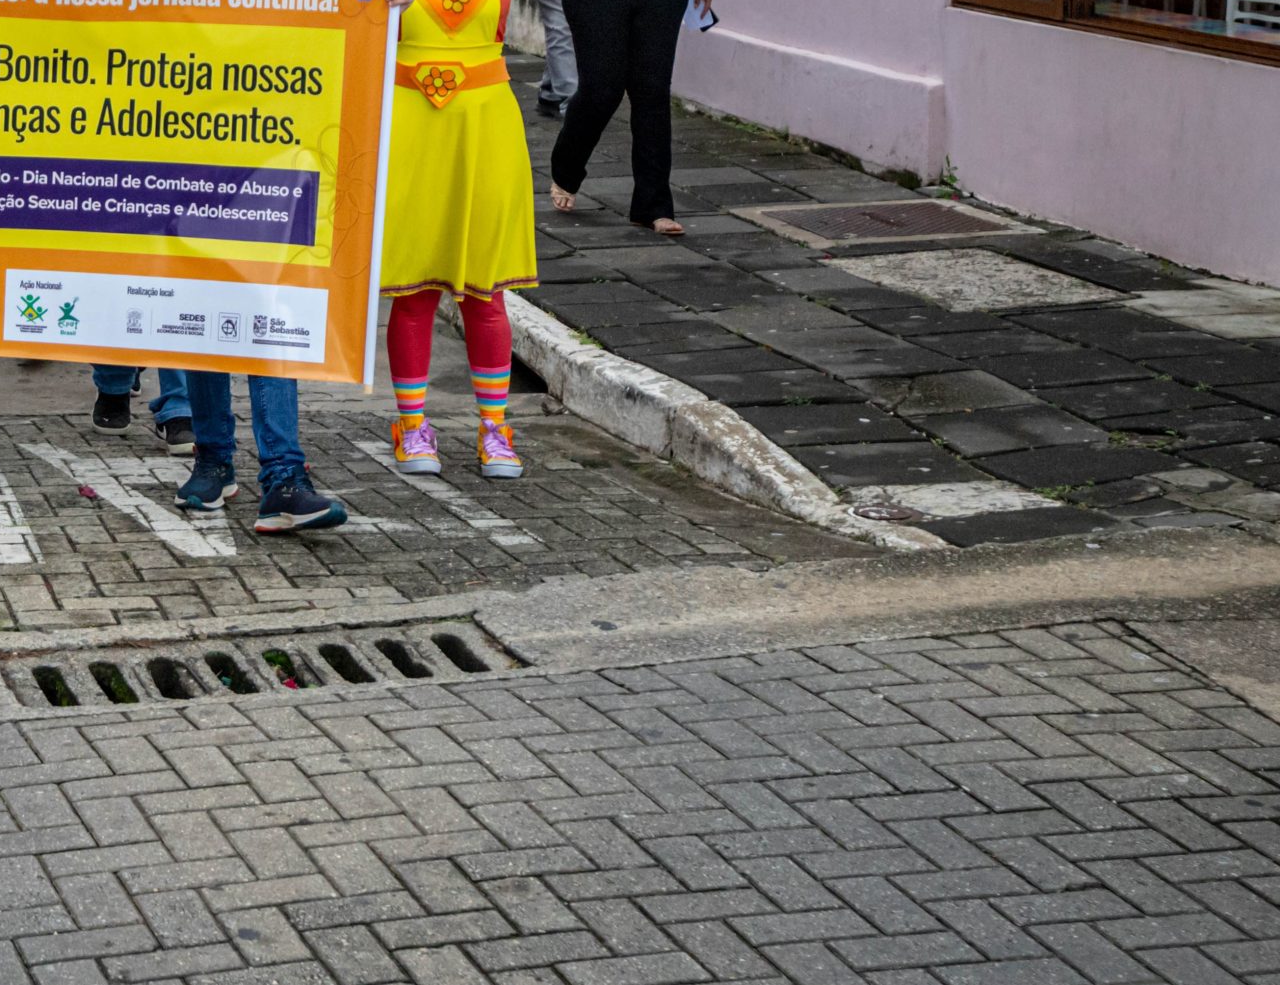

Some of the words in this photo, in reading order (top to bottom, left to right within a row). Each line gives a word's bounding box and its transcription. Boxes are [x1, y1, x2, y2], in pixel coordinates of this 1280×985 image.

[106, 48, 213, 96] Proteja
[222, 62, 323, 96] nossas
[70, 106, 87, 135] e
[95, 97, 301, 146] Adolescentes.
[22, 170, 48, 185] Dia
[52, 171, 118, 188] Nacional
[121, 174, 141, 189] de
[144, 175, 215, 193] Combate
[218, 183, 237, 194] ao
[240, 181, 290, 197] Abuso
[292, 186, 303, 198] e
[28, 195, 78, 210] Sexual
[81, 198, 101, 212] de
[105, 198, 171, 218] Crianças
[173, 204, 184, 216] e
[186, 202, 289, 223] Adolescentes
[19, 280, 35, 293] Ação
[36, 280, 63, 291] Nacional:
[127, 286, 159, 298] Realização
[159, 288, 174, 298] local:
[179, 313, 206, 323] SEDES
[269, 318, 286, 327] São
[269, 326, 310, 336] Sebastião
